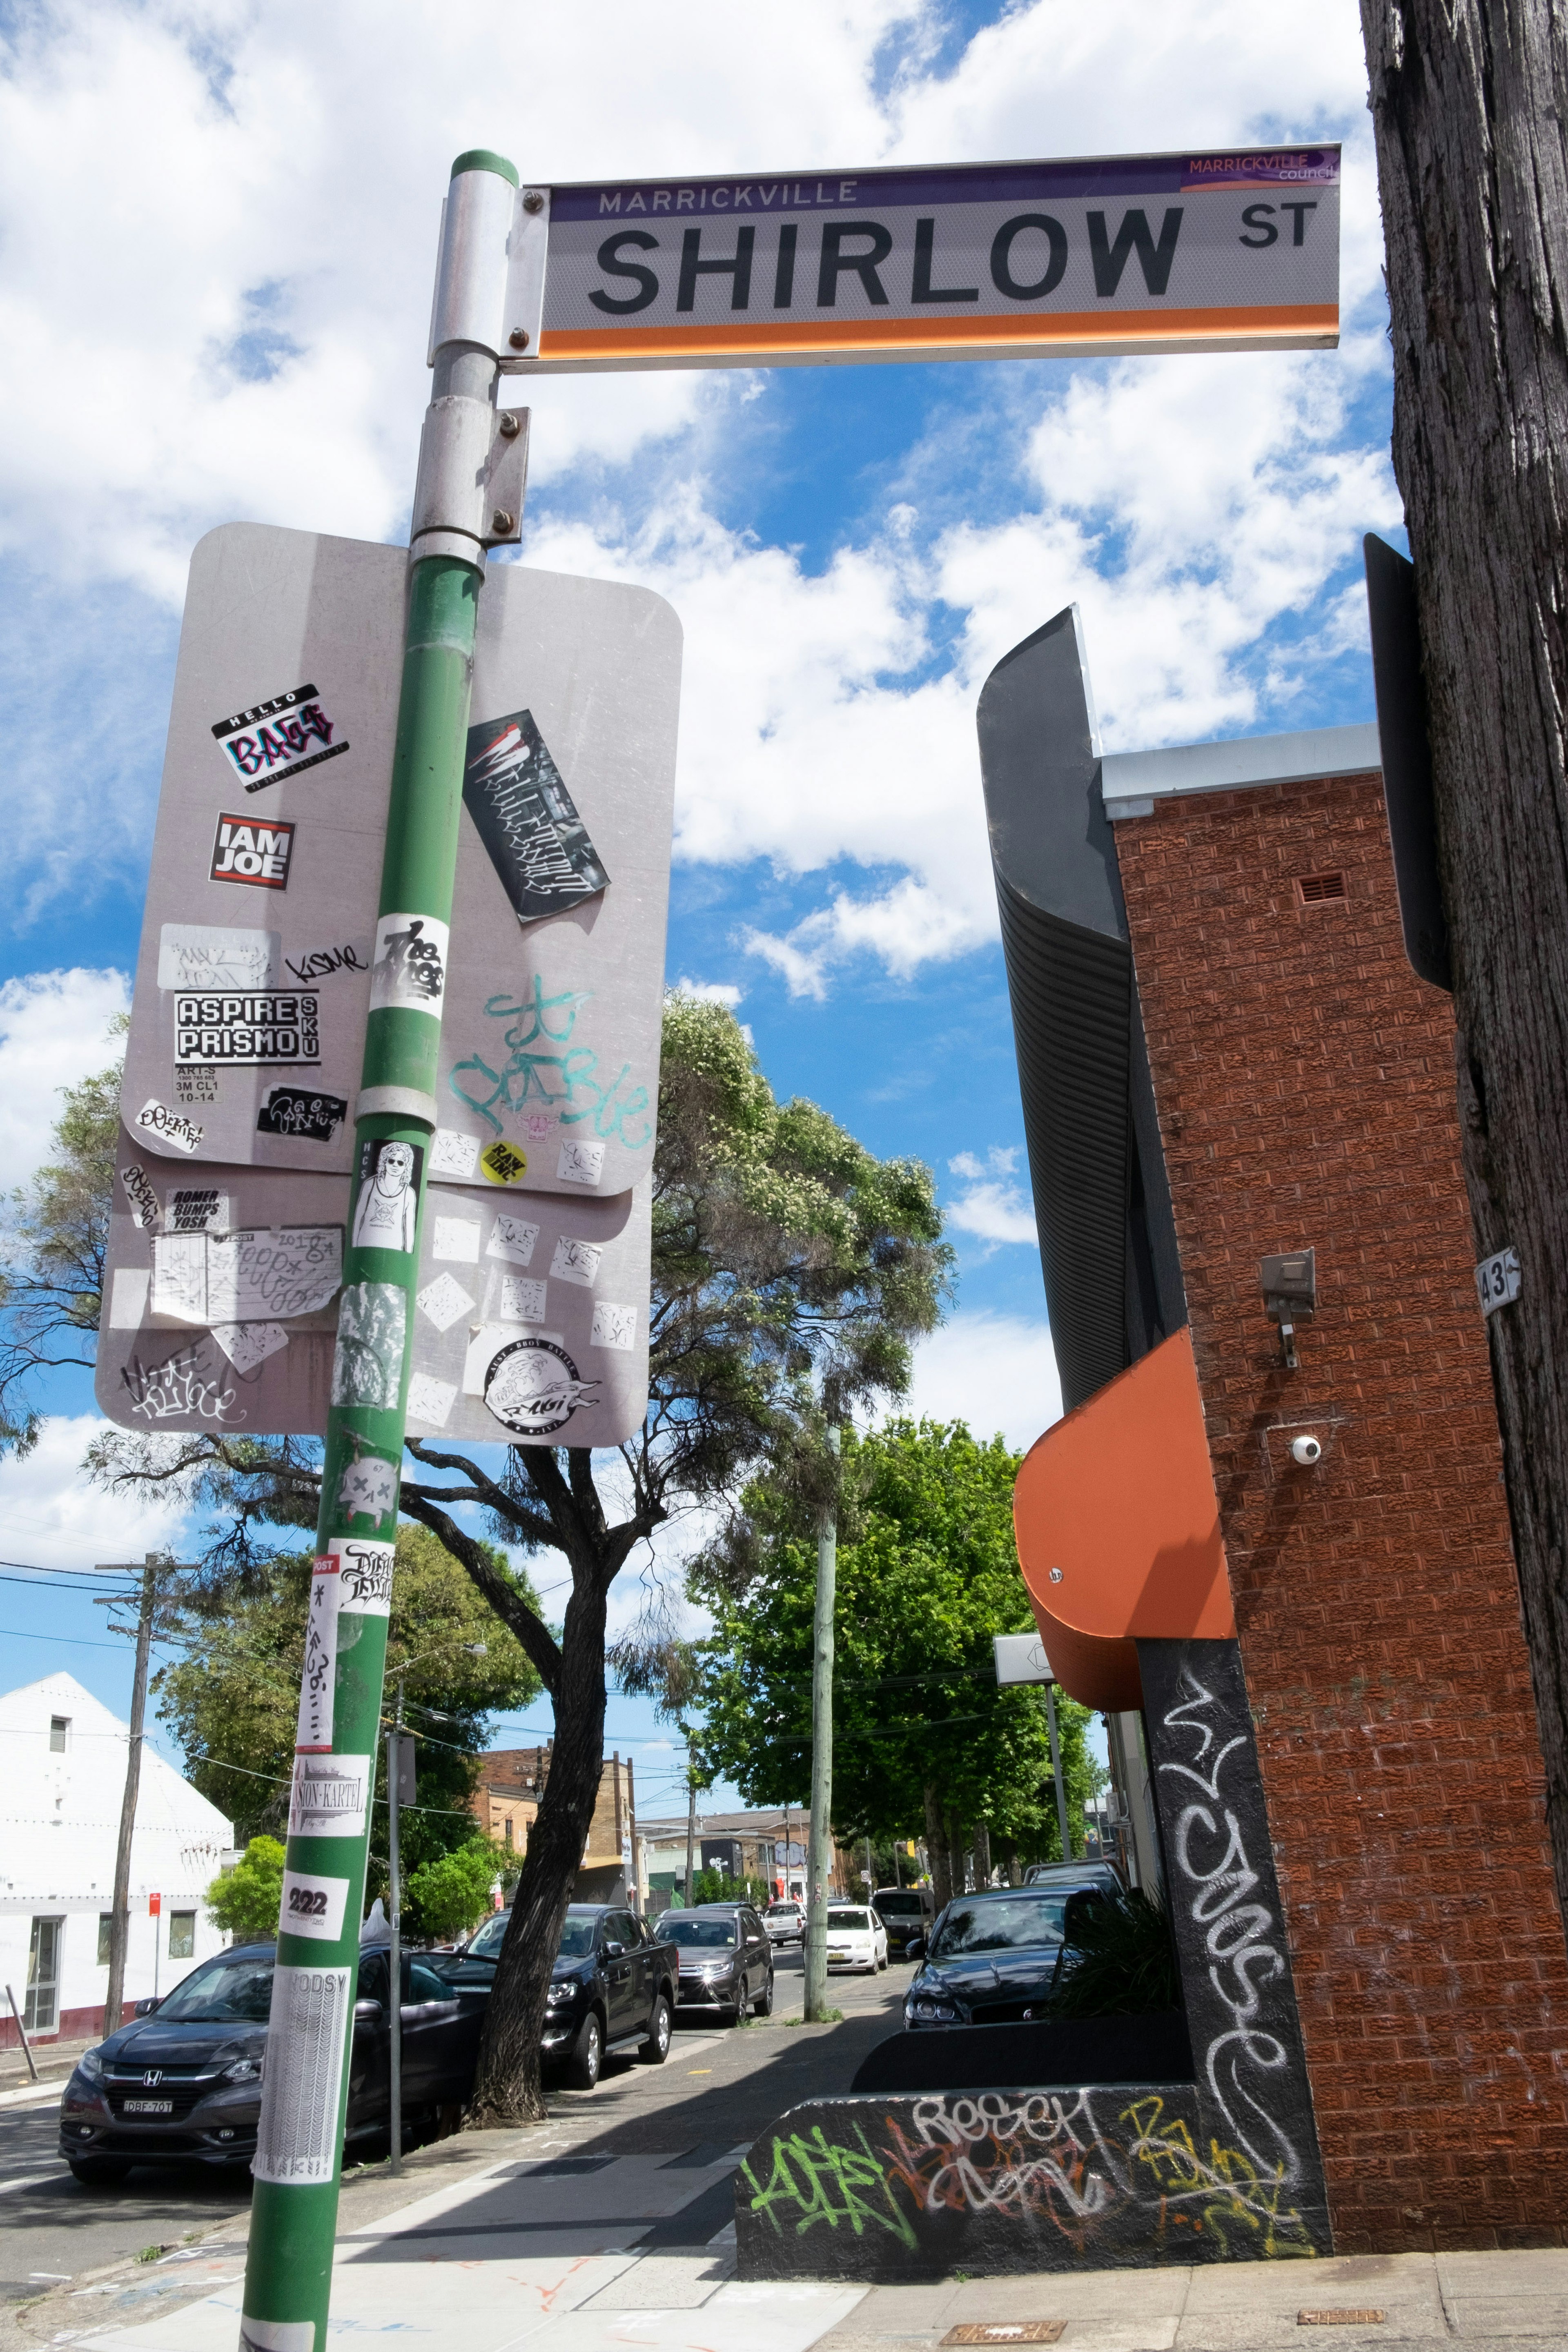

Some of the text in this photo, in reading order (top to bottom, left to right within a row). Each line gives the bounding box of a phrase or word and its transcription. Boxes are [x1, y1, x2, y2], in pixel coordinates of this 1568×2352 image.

[1190, 154, 1308, 174] MARRICKVILLE
[1279, 165, 1333, 180] council
[599, 181, 858, 214] MARRICKVILLE
[587, 201, 1317, 315] SHIRLOW ST
[230, 693, 296, 727] HELLO
[216, 848, 285, 880] JOE
[179, 998, 298, 1025] ASPIRE
[179, 1029, 298, 1056] PRISMO
[176, 1081, 218, 1091] 3M CL1
[179, 1093, 215, 1102] 10-14
[492, 1143, 526, 1172] RAW
[173, 1203, 220, 1216] BUMPS
[174, 1190, 219, 1204] ROMER
[174, 1216, 209, 1229] YOSH
[1481, 1261, 1505, 1304] 43
[491, 1339, 575, 1373] AUST BBOY BATTLE
[373, 1464, 384, 1473] 67
[323, 1778, 363, 1813] KARTEL
[288, 1886, 328, 1915] 222
